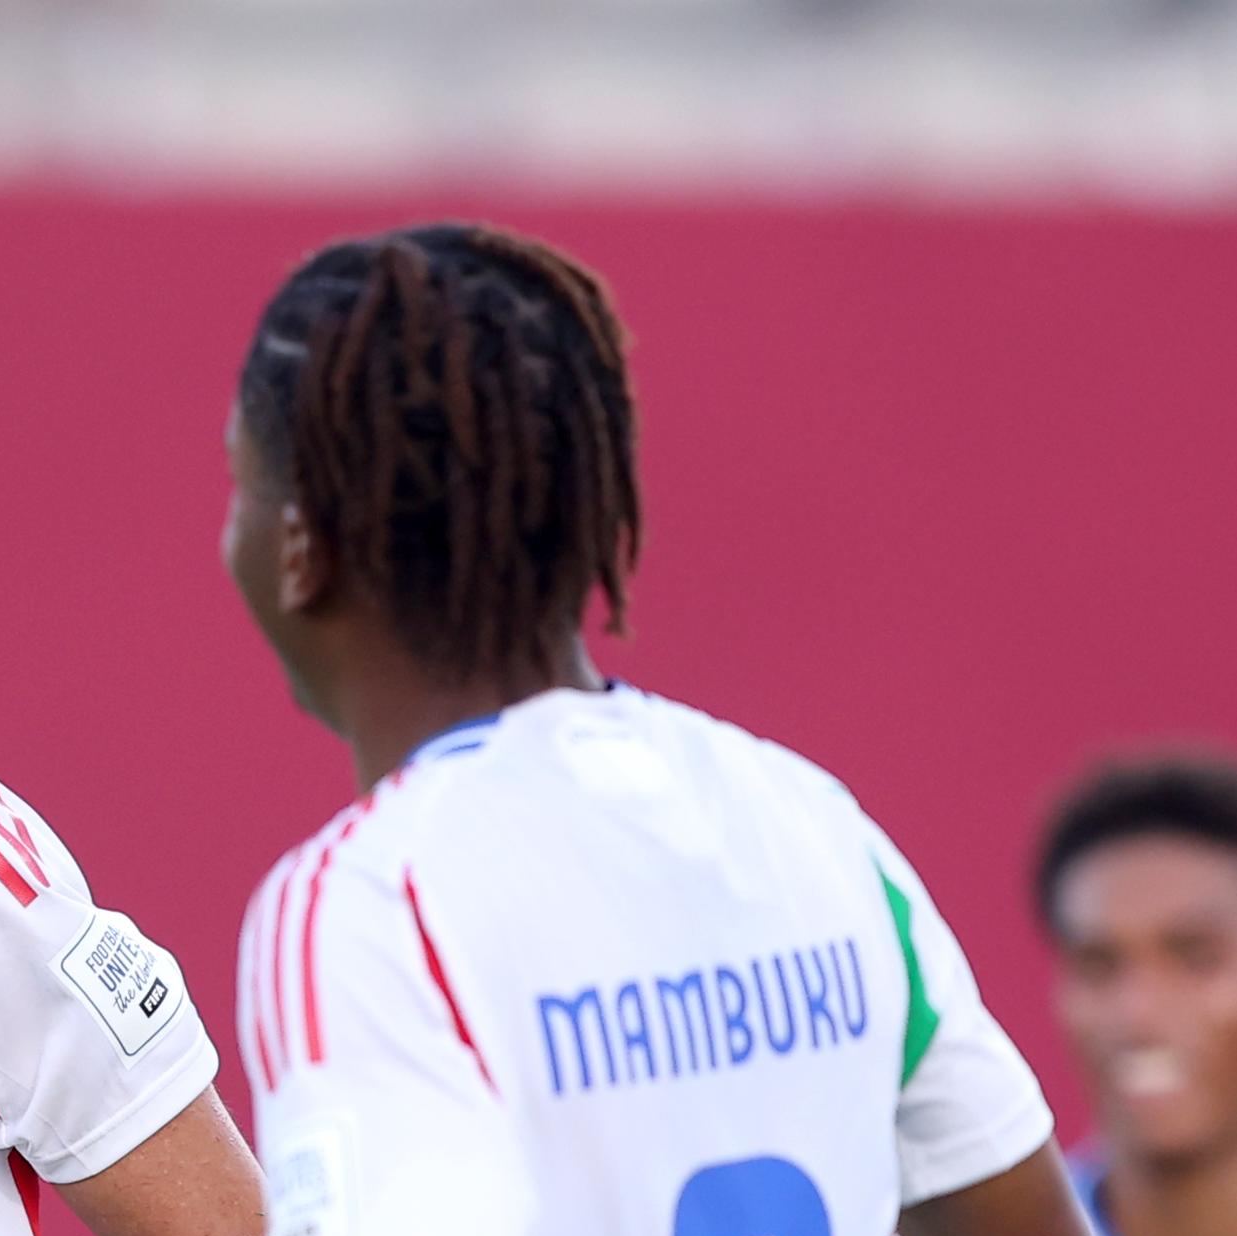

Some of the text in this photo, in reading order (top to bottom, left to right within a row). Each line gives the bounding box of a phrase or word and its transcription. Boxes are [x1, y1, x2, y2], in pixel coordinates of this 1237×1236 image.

[85, 925, 121, 974] FOOTBA
[113, 989, 136, 1014] the
[143, 983, 165, 1013] FIFA
[537, 937, 867, 1096] MAMBUKU
